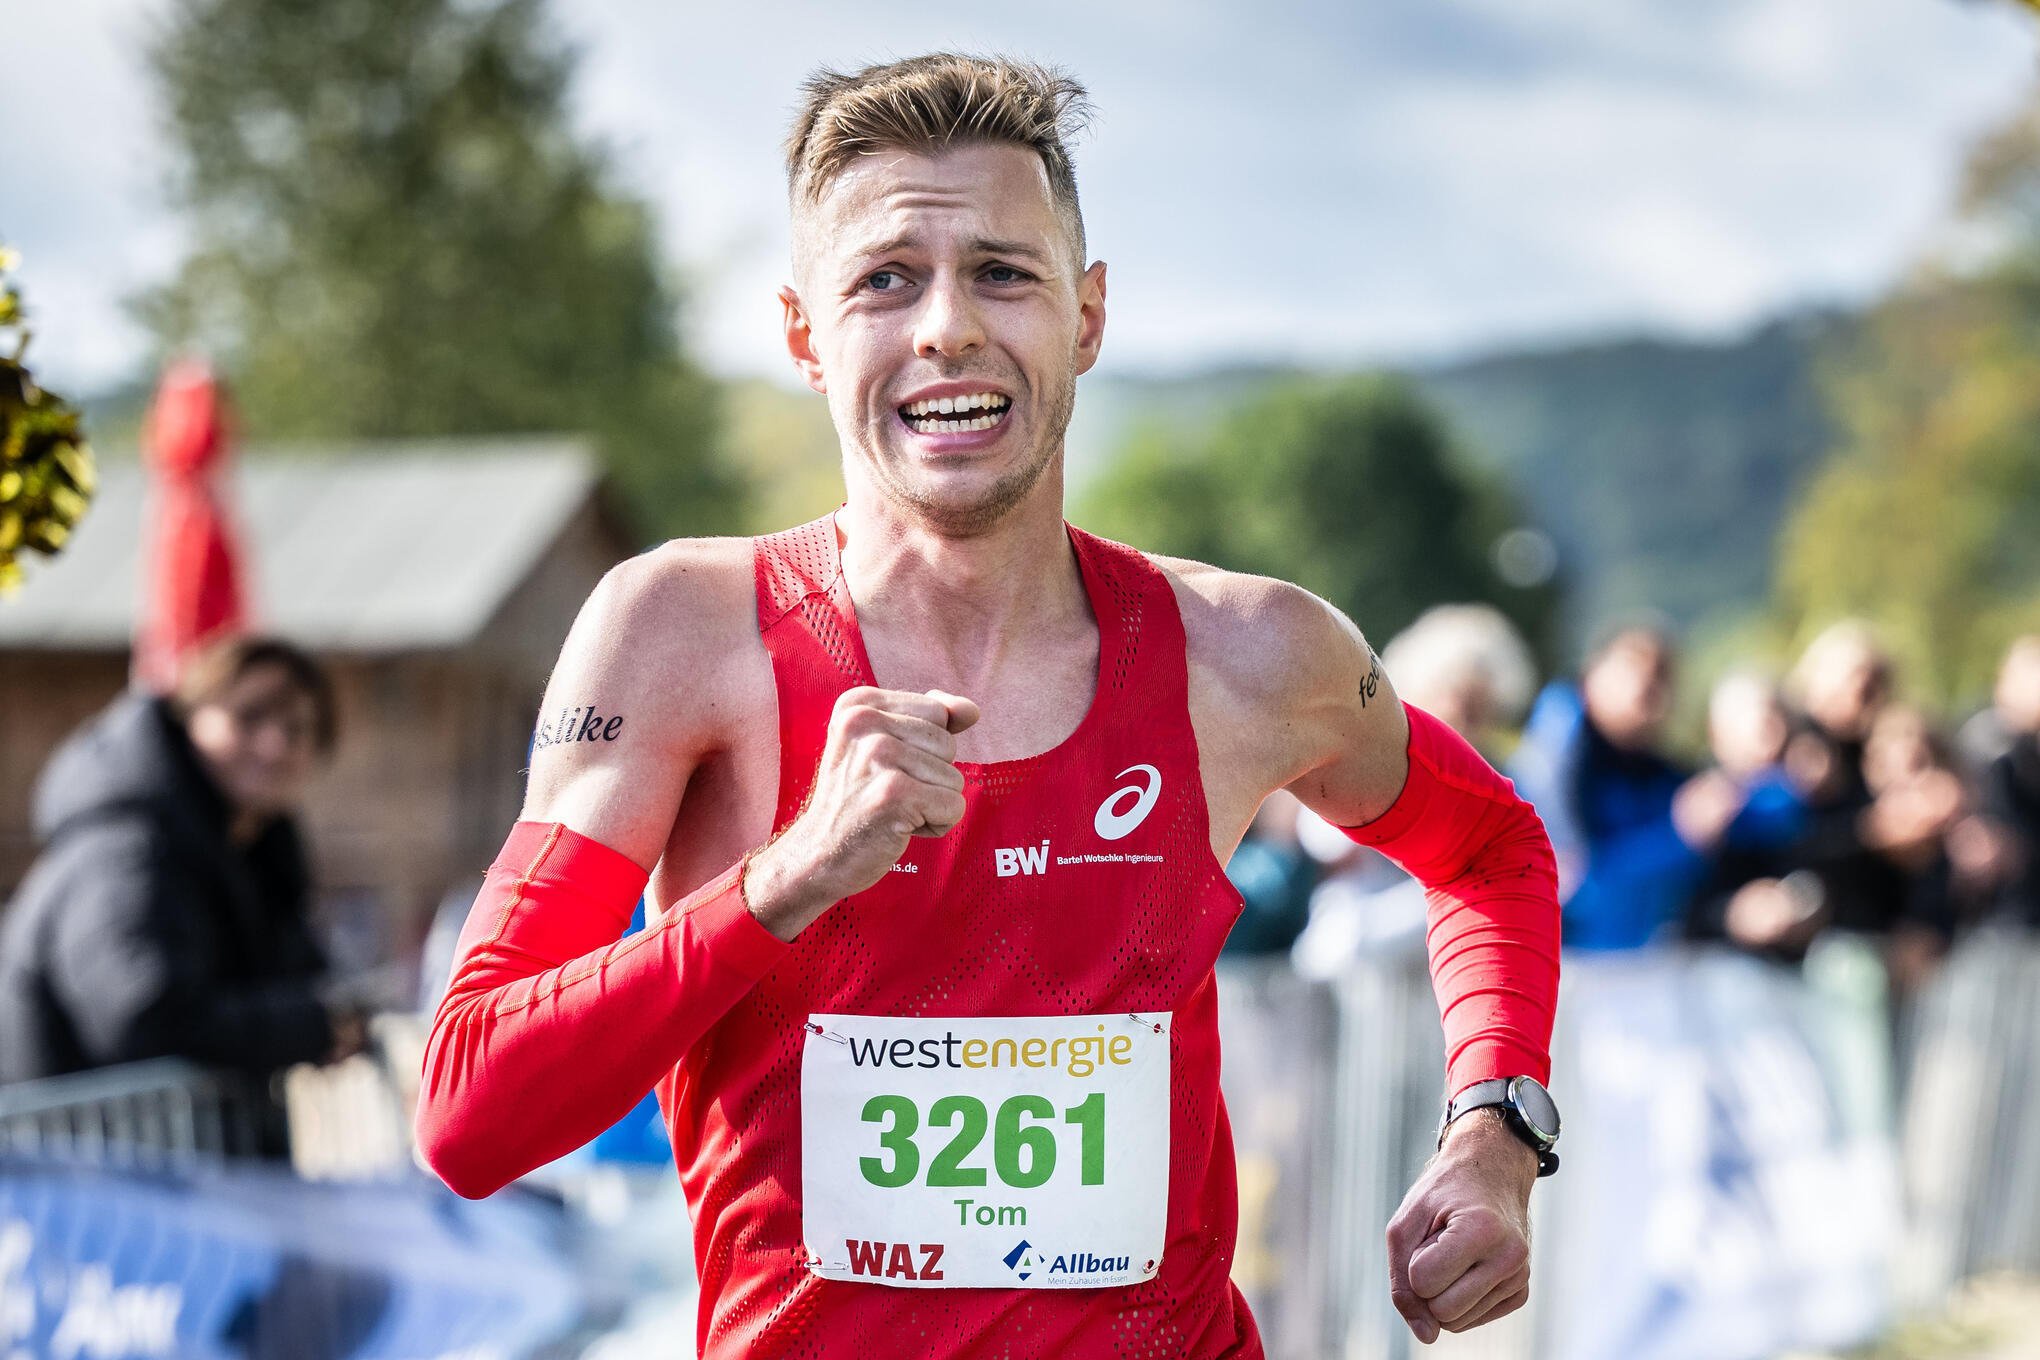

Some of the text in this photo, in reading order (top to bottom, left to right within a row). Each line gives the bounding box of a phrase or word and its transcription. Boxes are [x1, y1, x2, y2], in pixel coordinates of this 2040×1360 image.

[1056, 855, 1083, 865] Bartel
[1083, 853, 1124, 863] Wotschke
[1124, 853, 1164, 865] Ingenieure
[849, 1024, 1133, 1078] westenergie
[859, 1093, 1105, 1189] 3261
[953, 1199, 1027, 1226] Tom
[846, 1239, 945, 1281] WAZ
[1048, 1253, 1130, 1274] Allbau
[1047, 1274, 1128, 1285] Mein Zuhause in Essen
